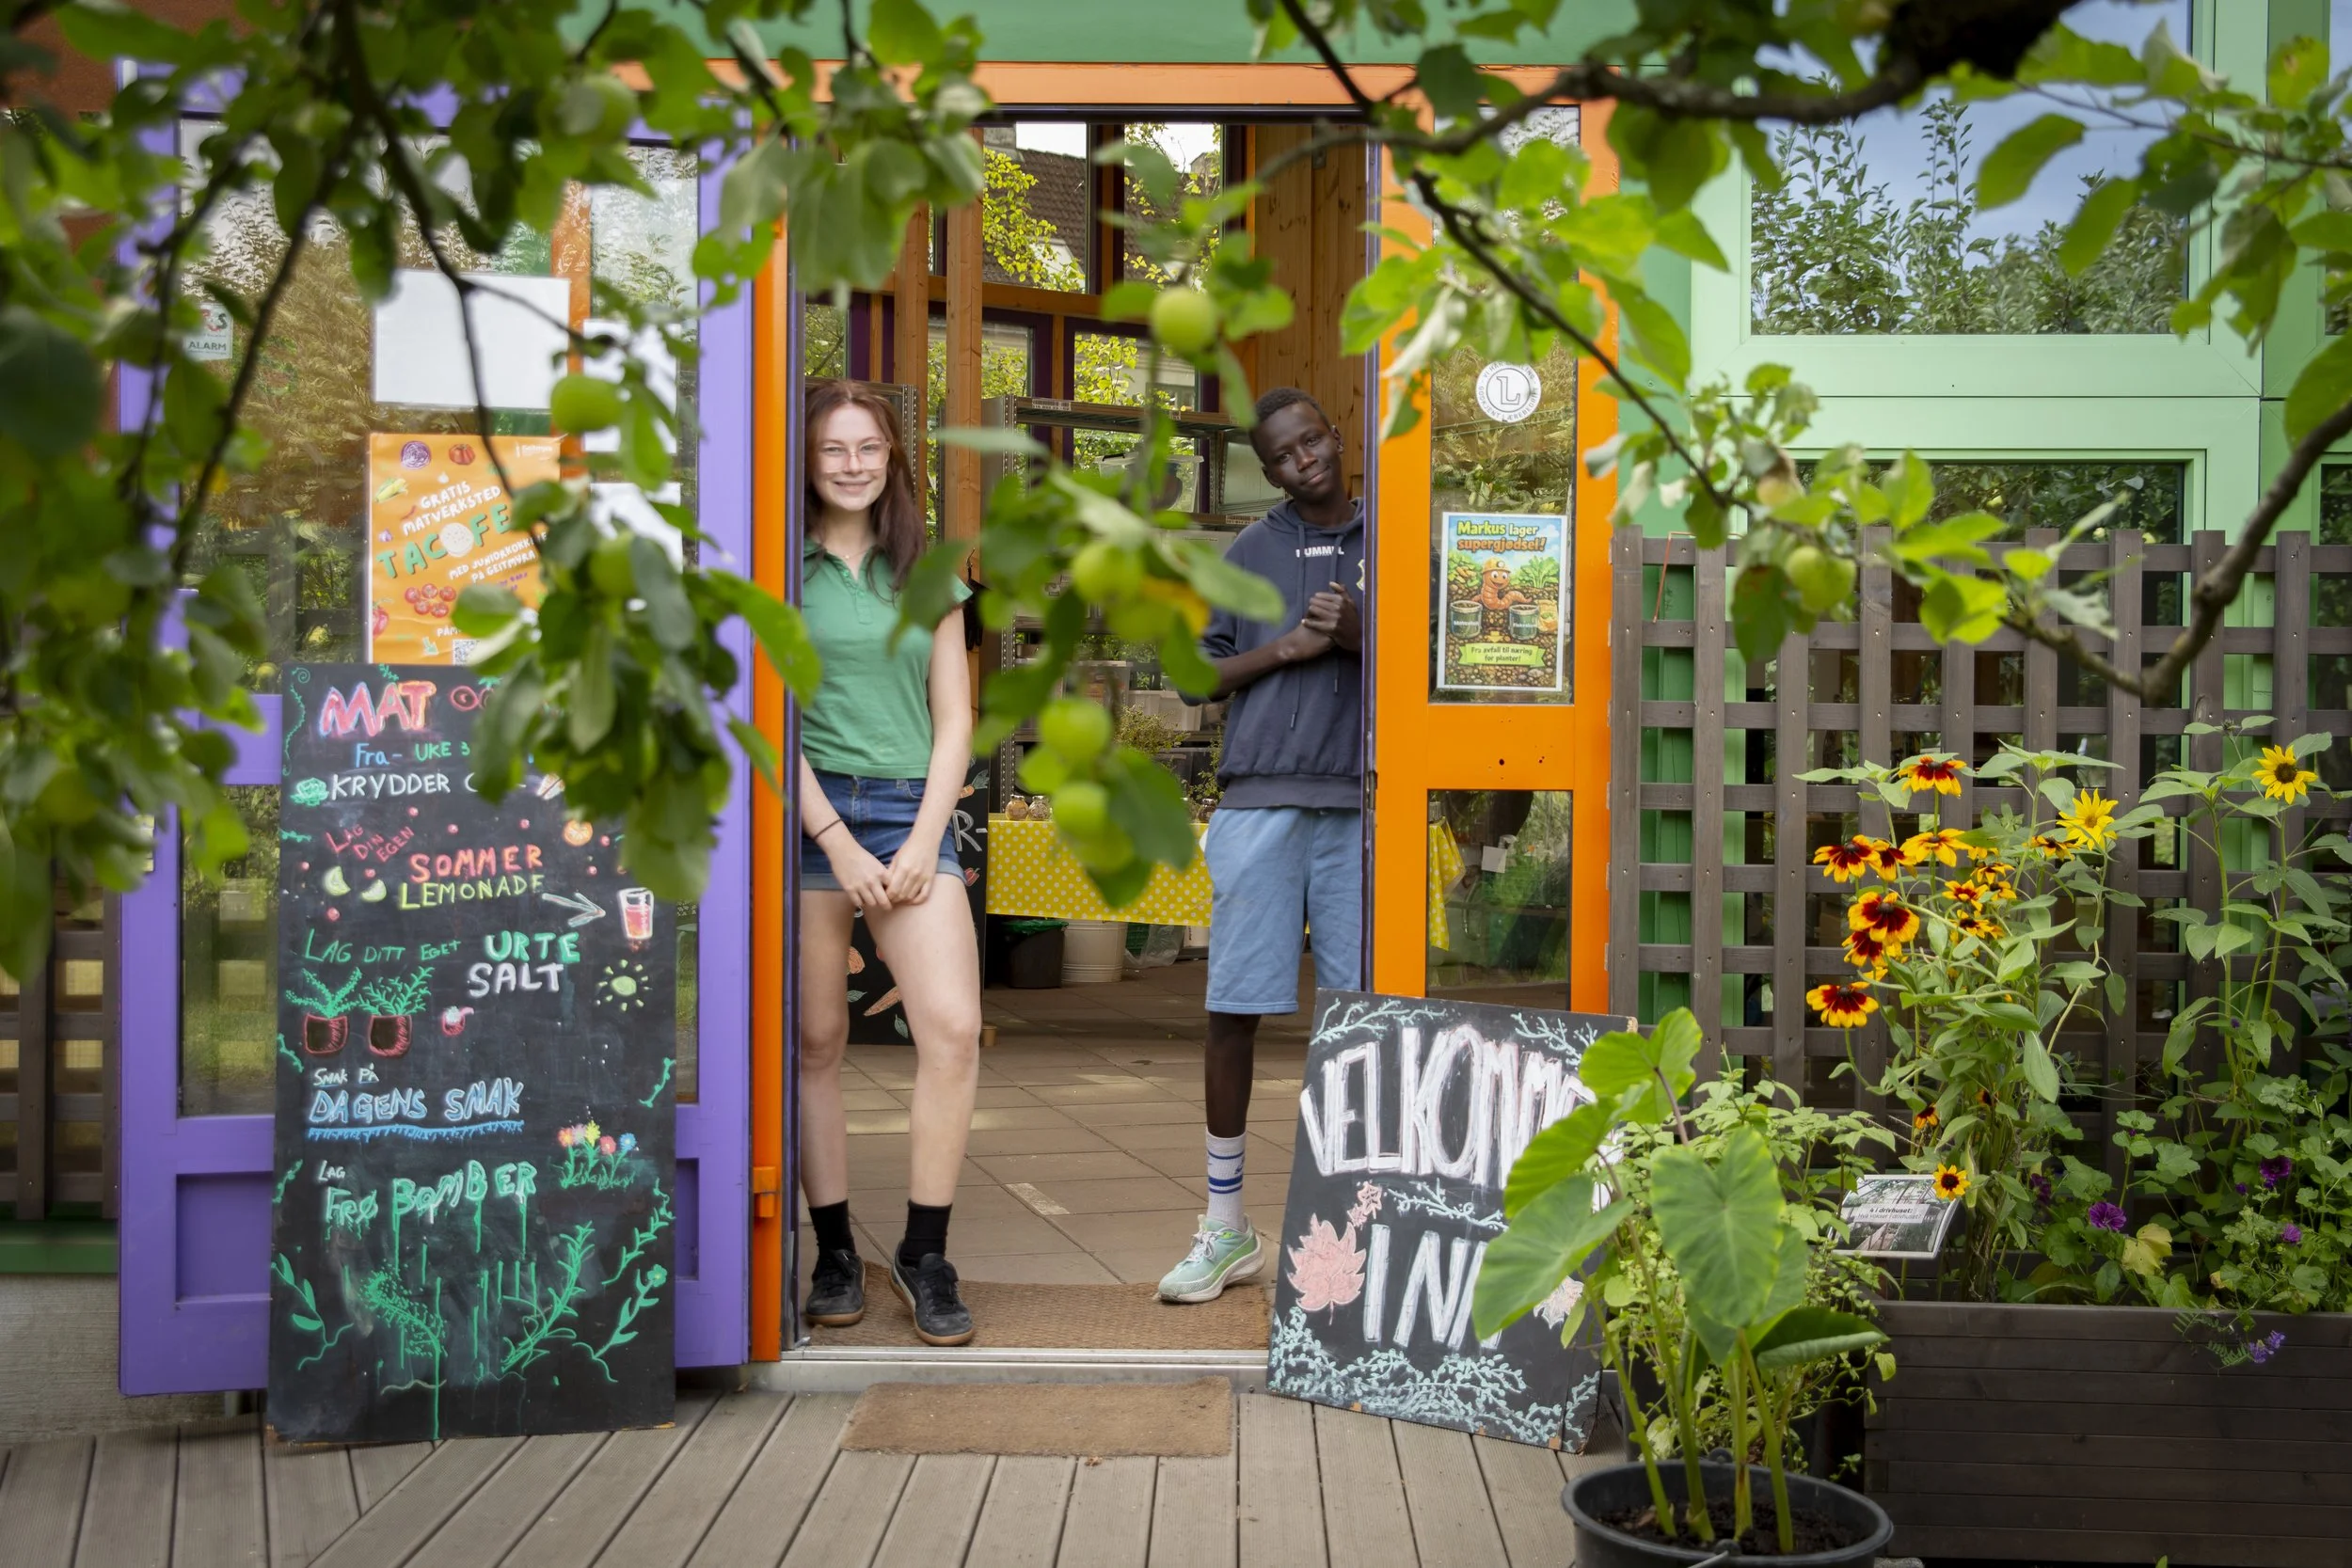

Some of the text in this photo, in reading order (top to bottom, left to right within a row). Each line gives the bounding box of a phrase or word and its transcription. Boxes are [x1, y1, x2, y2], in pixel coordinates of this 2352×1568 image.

[189, 341, 227, 351] ALARM
[403, 484, 502, 536] MATVERKSTED
[421, 482, 471, 509] GRATIS
[1457, 520, 1539, 537] Markus lager
[1457, 537, 1547, 553] supergjødsel!
[449, 564, 469, 580] MED
[486, 549, 536, 576] GEITMYRA
[318, 679, 437, 737] MAT
[415, 740, 452, 762] UKE
[460, 740, 471, 756] 3
[331, 772, 451, 801] KRYDDER
[353, 833, 385, 860] DIN
[376, 826, 414, 862] EGEN
[409, 844, 544, 884] SOMMER
[398, 874, 546, 911] LEMONADE
[304, 927, 352, 963] LAG
[485, 930, 581, 963] URTE
[469, 962, 564, 997] SALT
[308, 1077, 524, 1124] DAGENS SMAK
[326, 1186, 379, 1227] FRØ
